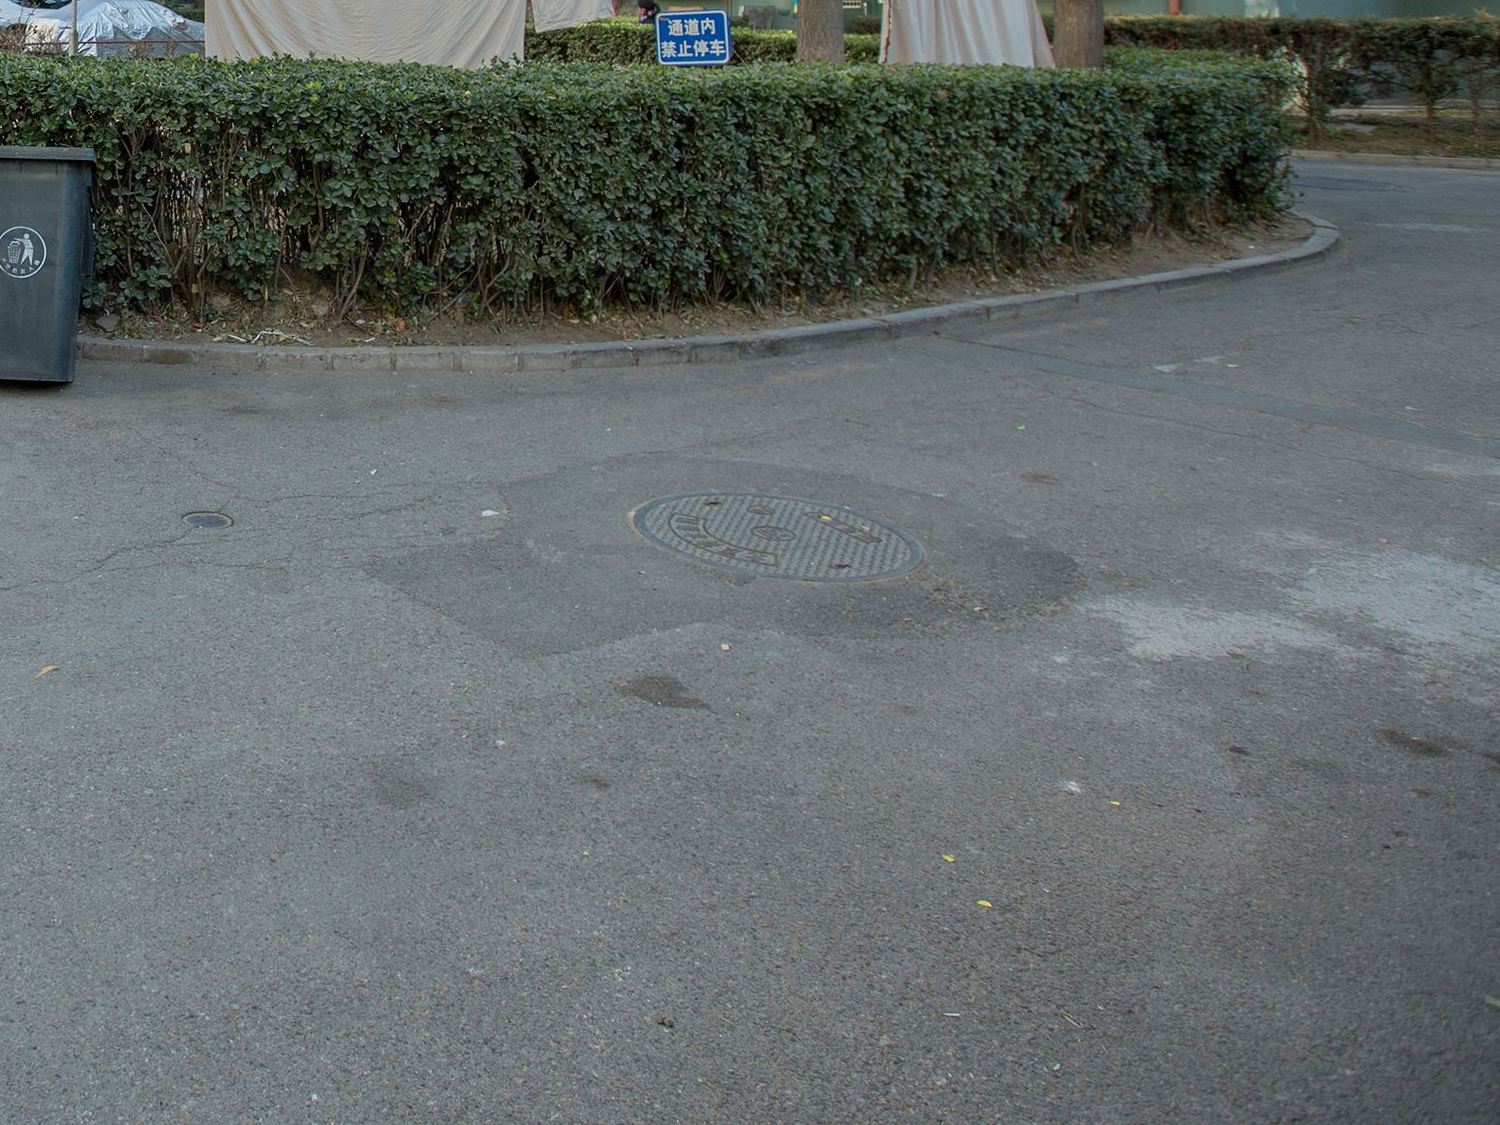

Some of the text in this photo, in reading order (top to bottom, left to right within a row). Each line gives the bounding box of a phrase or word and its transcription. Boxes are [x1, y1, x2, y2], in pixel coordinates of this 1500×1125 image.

[668, 18, 716, 36] 通道内
[661, 39, 726, 58] 禁止停车
